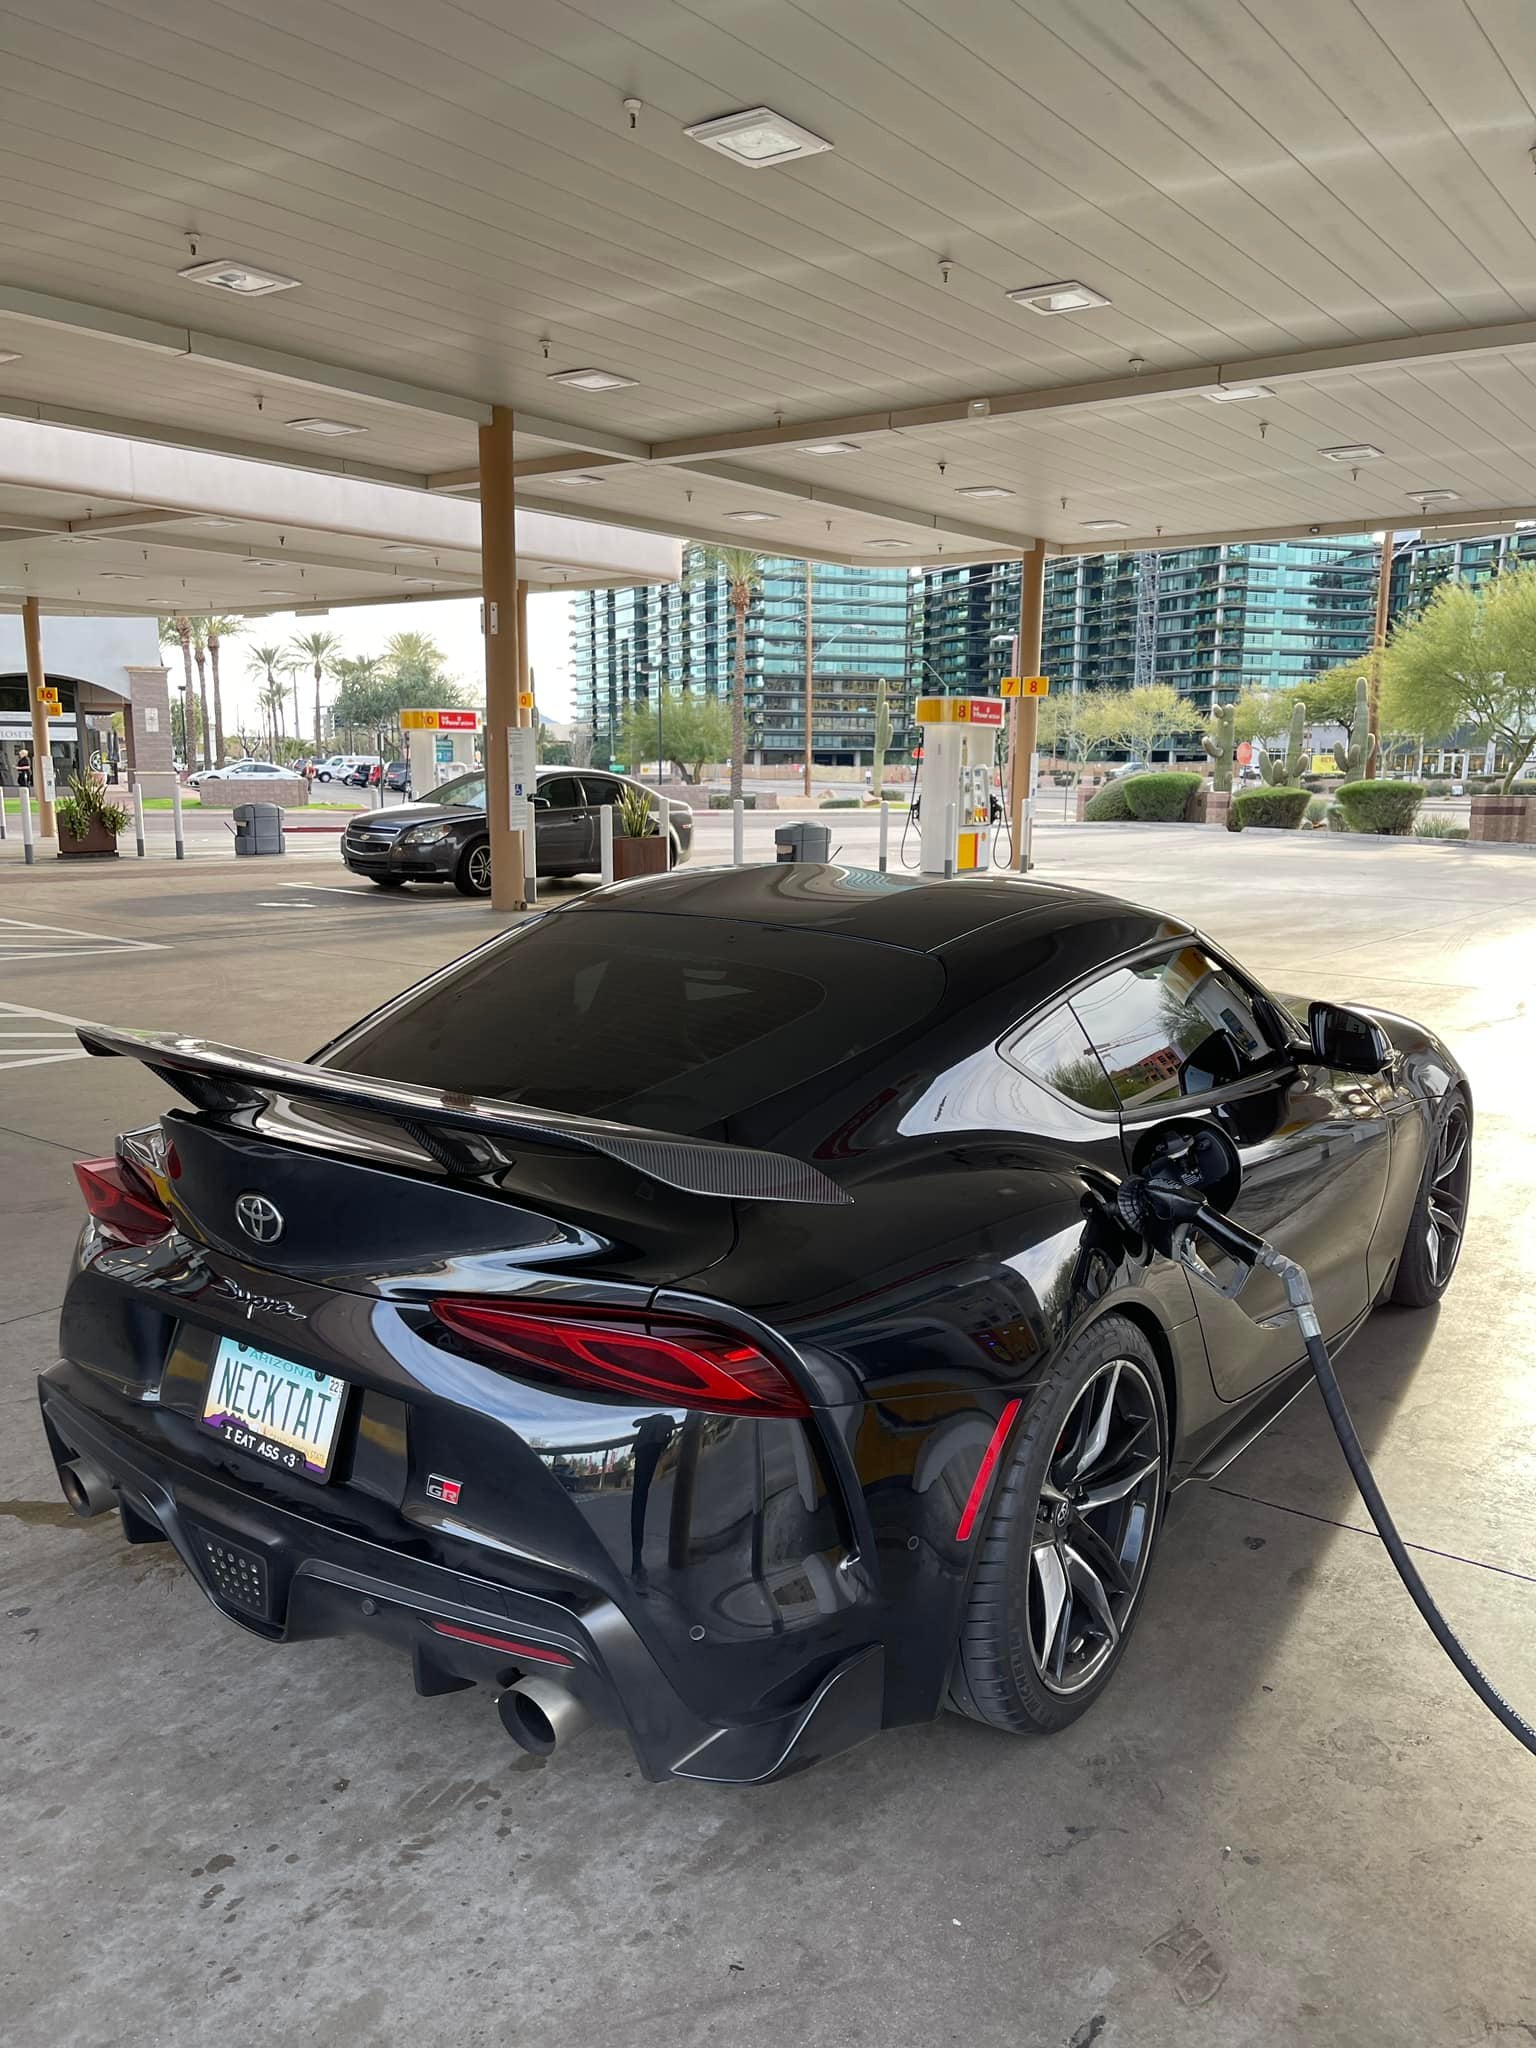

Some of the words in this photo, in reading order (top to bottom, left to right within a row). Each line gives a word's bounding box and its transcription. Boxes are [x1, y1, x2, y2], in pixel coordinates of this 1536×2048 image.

[40, 690, 53, 699] 16
[1007, 682, 1014, 693] 7
[1030, 681, 1037, 693] 8
[958, 705, 966, 718] 8
[210, 1275, 307, 1320] Supra
[248, 1349, 314, 1381] ARIZONA
[328, 1379, 340, 1394] 22
[217, 1357, 332, 1445] NECKTAT
[224, 1426, 231, 1440] I
[233, 1428, 256, 1449] EAT
[256, 1441, 280, 1460] ASS
[283, 1453, 296, 1468] <3
[429, 1481, 456, 1501] GR
